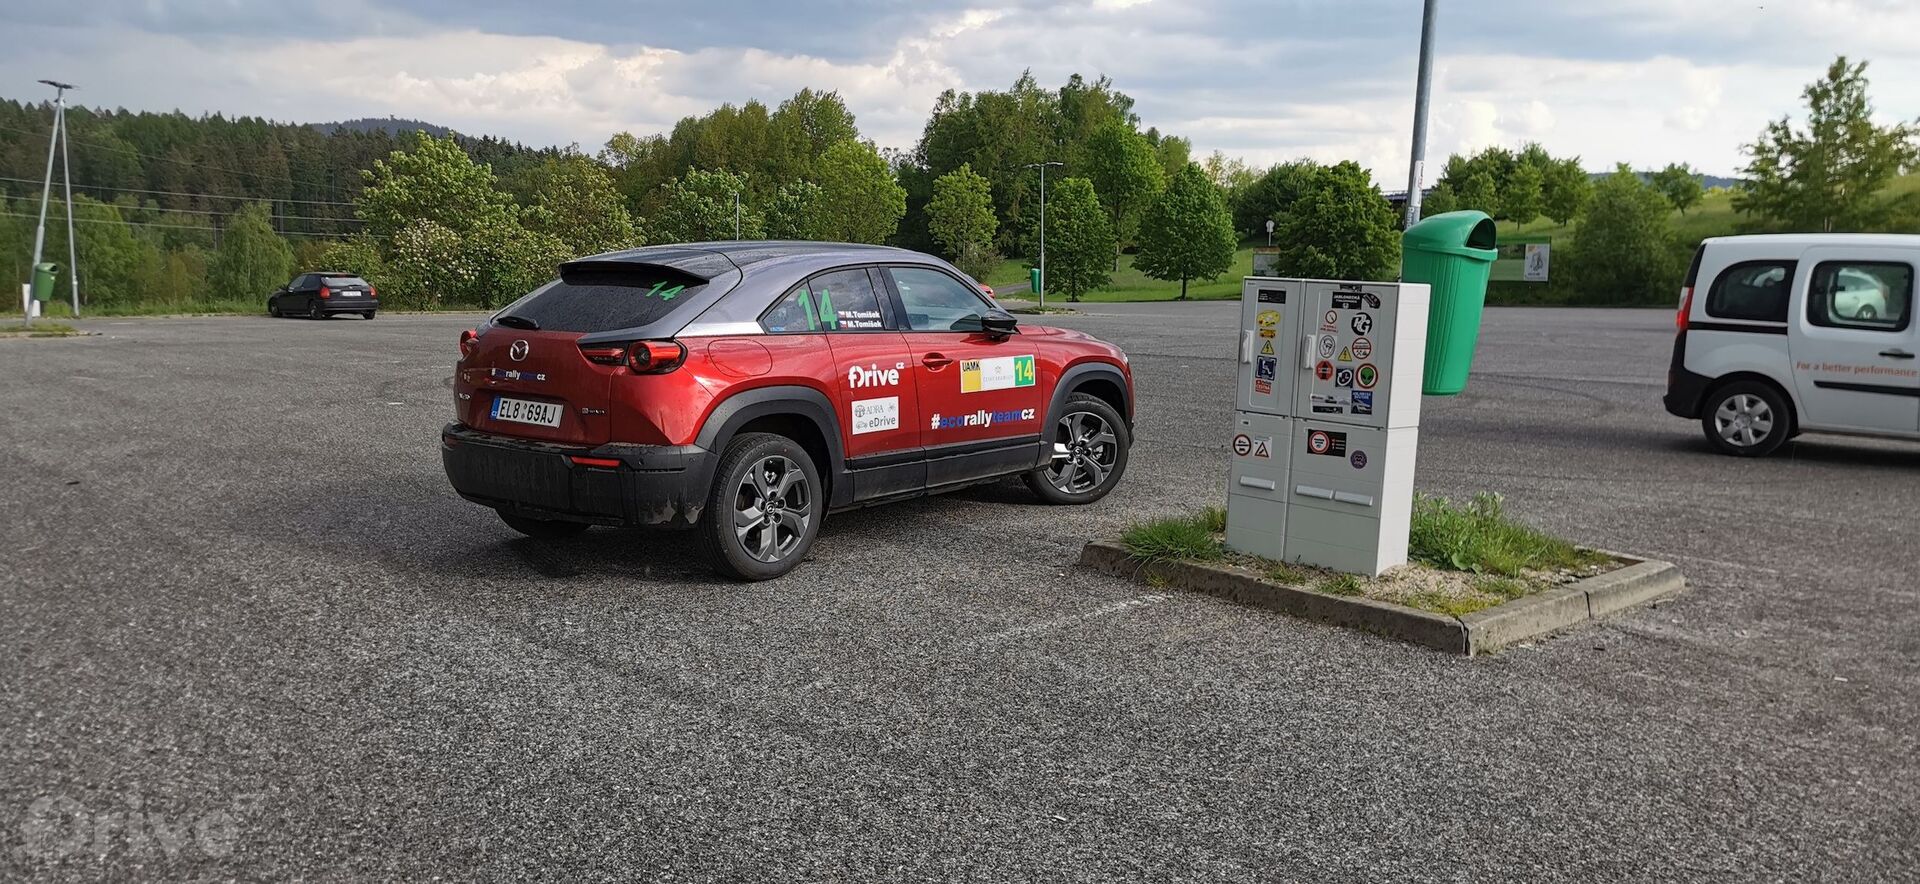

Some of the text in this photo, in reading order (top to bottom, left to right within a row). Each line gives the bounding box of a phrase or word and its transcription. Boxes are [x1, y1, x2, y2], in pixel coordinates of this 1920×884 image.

[645, 280, 685, 301] 14
[797, 288, 838, 331] 14
[1015, 359, 1033, 382] 14
[1796, 361, 1810, 370] For
[1822, 362, 1851, 373] better
[1854, 365, 1917, 377] performance
[869, 416, 896, 427] eDrive
[931, 408, 1035, 429] #ecorallyteamcz
